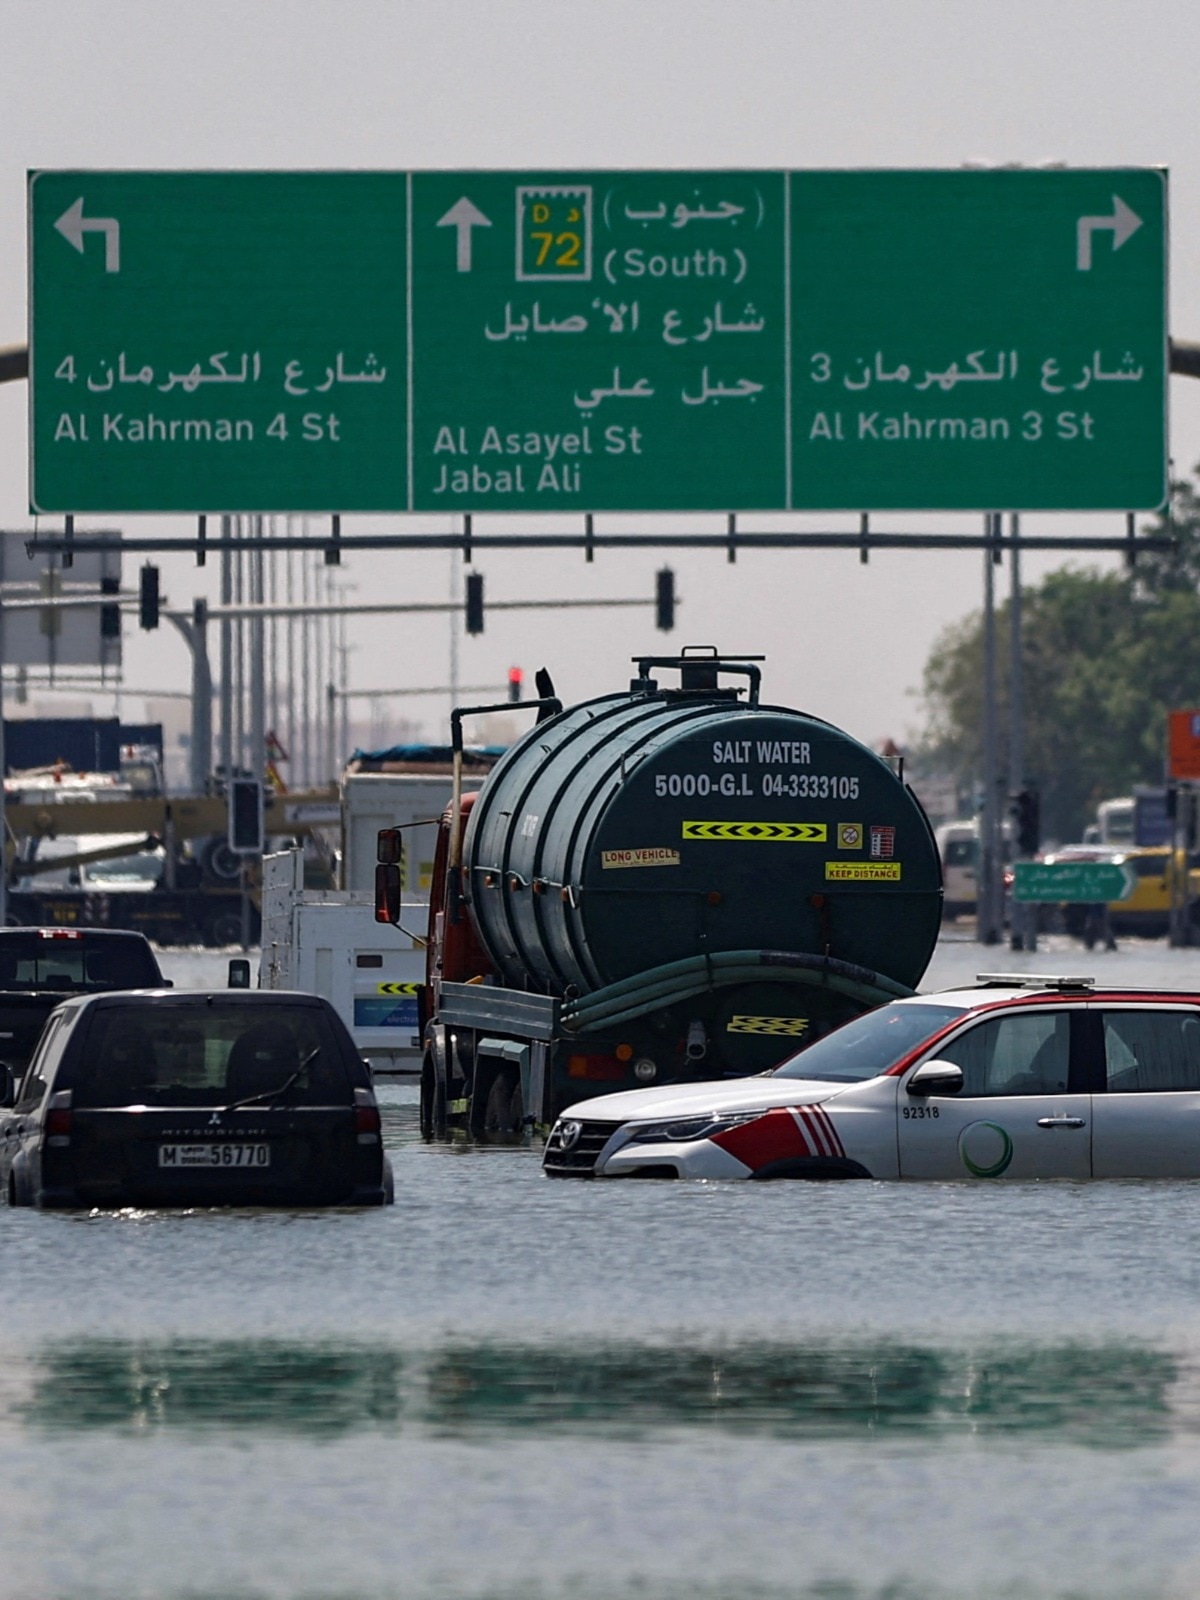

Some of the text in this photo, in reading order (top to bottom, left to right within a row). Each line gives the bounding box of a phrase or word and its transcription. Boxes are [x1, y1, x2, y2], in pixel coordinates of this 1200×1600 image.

[533, 204, 549, 223] D
[531, 231, 581, 267] 72
[604, 248, 747, 284] (South)
[661, 300, 765, 345] شارع
[54, 351, 387, 395] شارع الكهرمان 4
[810, 350, 1143, 394] شارع الكهرمان 3
[573, 366, 765, 419] جبل علي
[54, 413, 340, 441] Al Kahrman 4 St
[810, 411, 1094, 440] Al Kahrman 3 St
[433, 426, 642, 461] Al Asayel St
[433, 464, 581, 493] Jabal Ali
[712, 741, 811, 764] SALT WATER
[655, 773, 860, 800] 5000-G.L 04-3333105
[605, 852, 631, 862] LONG
[635, 850, 677, 860] VEHICLE
[829, 870, 898, 878] KEEP DISTANCE
[903, 1106, 940, 1119] 92318
[163, 1147, 176, 1164] M
[211, 1146, 267, 1165] 56770
